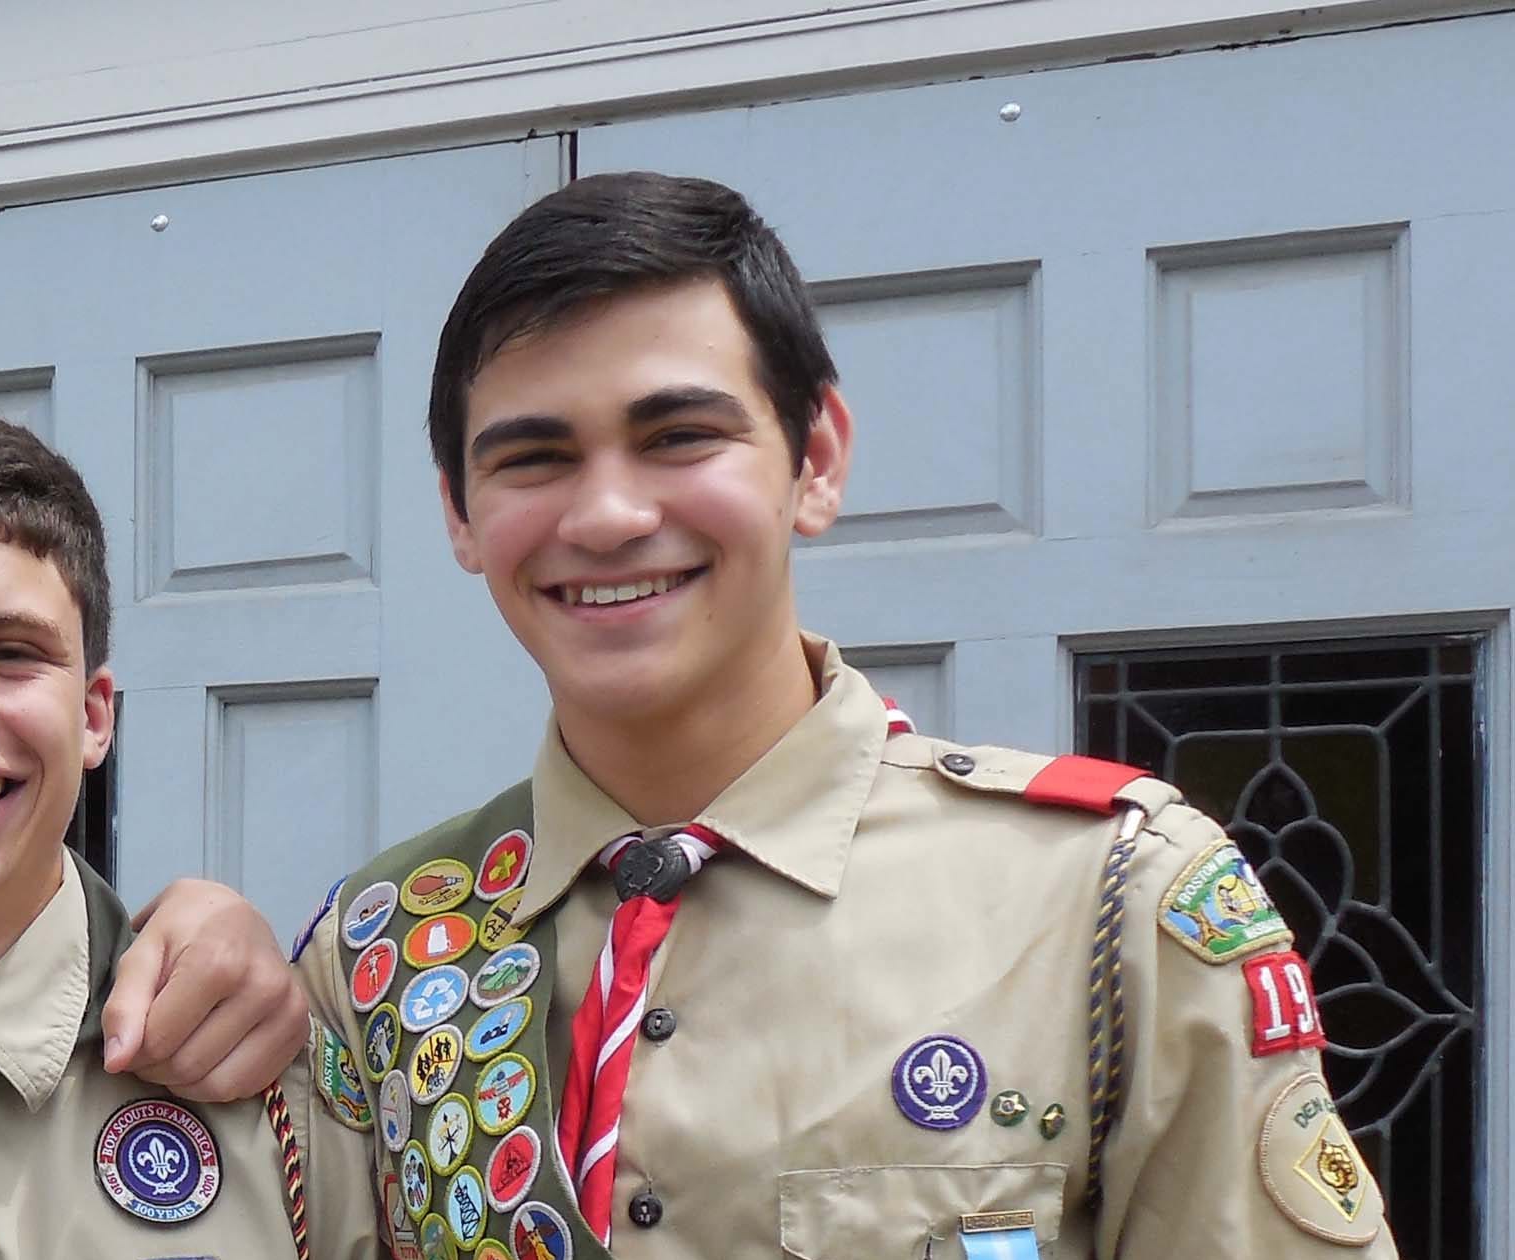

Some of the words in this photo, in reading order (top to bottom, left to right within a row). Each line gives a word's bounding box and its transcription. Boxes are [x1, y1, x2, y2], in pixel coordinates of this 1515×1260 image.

[104, 1127, 119, 1156] BOY
[116, 1105, 154, 1129] SCOUTS
[169, 1111, 214, 1160] AMERICA
[106, 1172, 123, 1196] 1910
[199, 1174, 215, 1199] 2010
[135, 1204, 154, 1218] 100
[156, 1203, 196, 1219] YEARS
